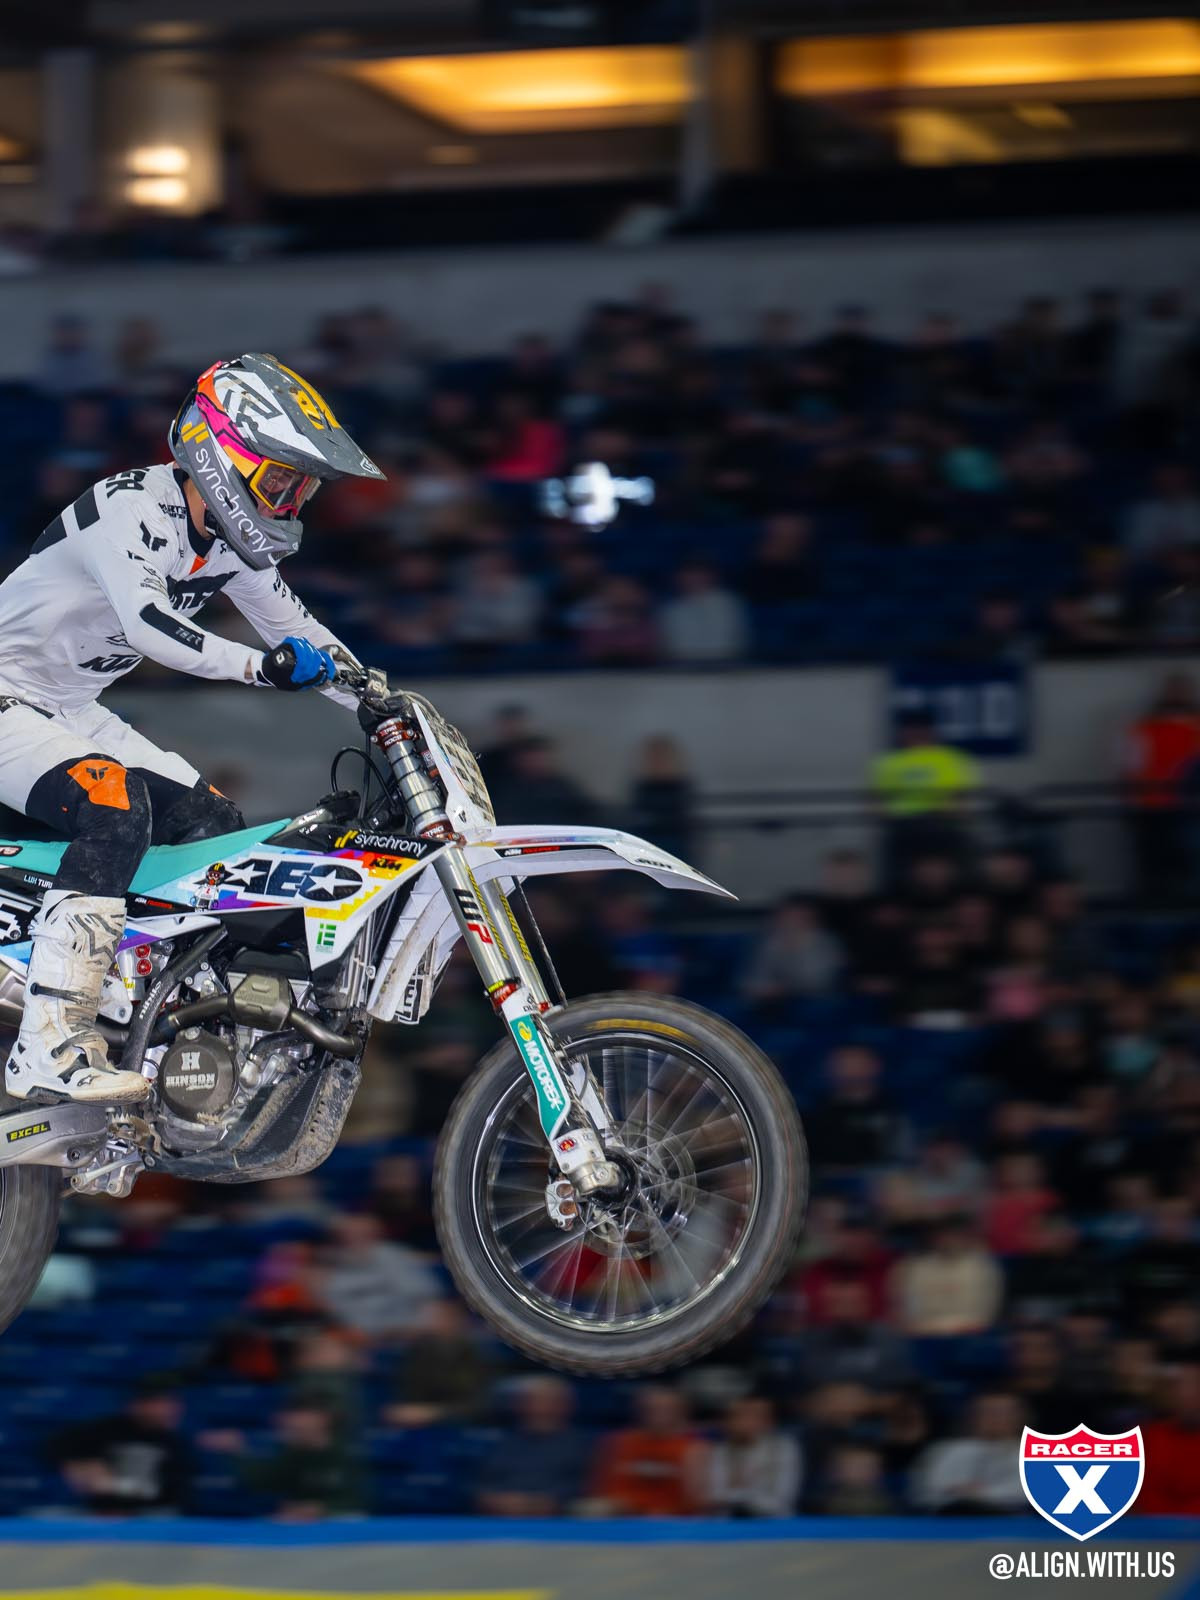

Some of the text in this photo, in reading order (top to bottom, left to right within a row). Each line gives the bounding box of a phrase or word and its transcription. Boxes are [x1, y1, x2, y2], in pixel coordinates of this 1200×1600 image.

[195, 447, 274, 553] synchrony
[354, 833, 428, 857] synchrony
[369, 858, 402, 871] KTM
[523, 1041, 564, 1112] MOTOREX
[10, 1124, 48, 1141] EXCEL
